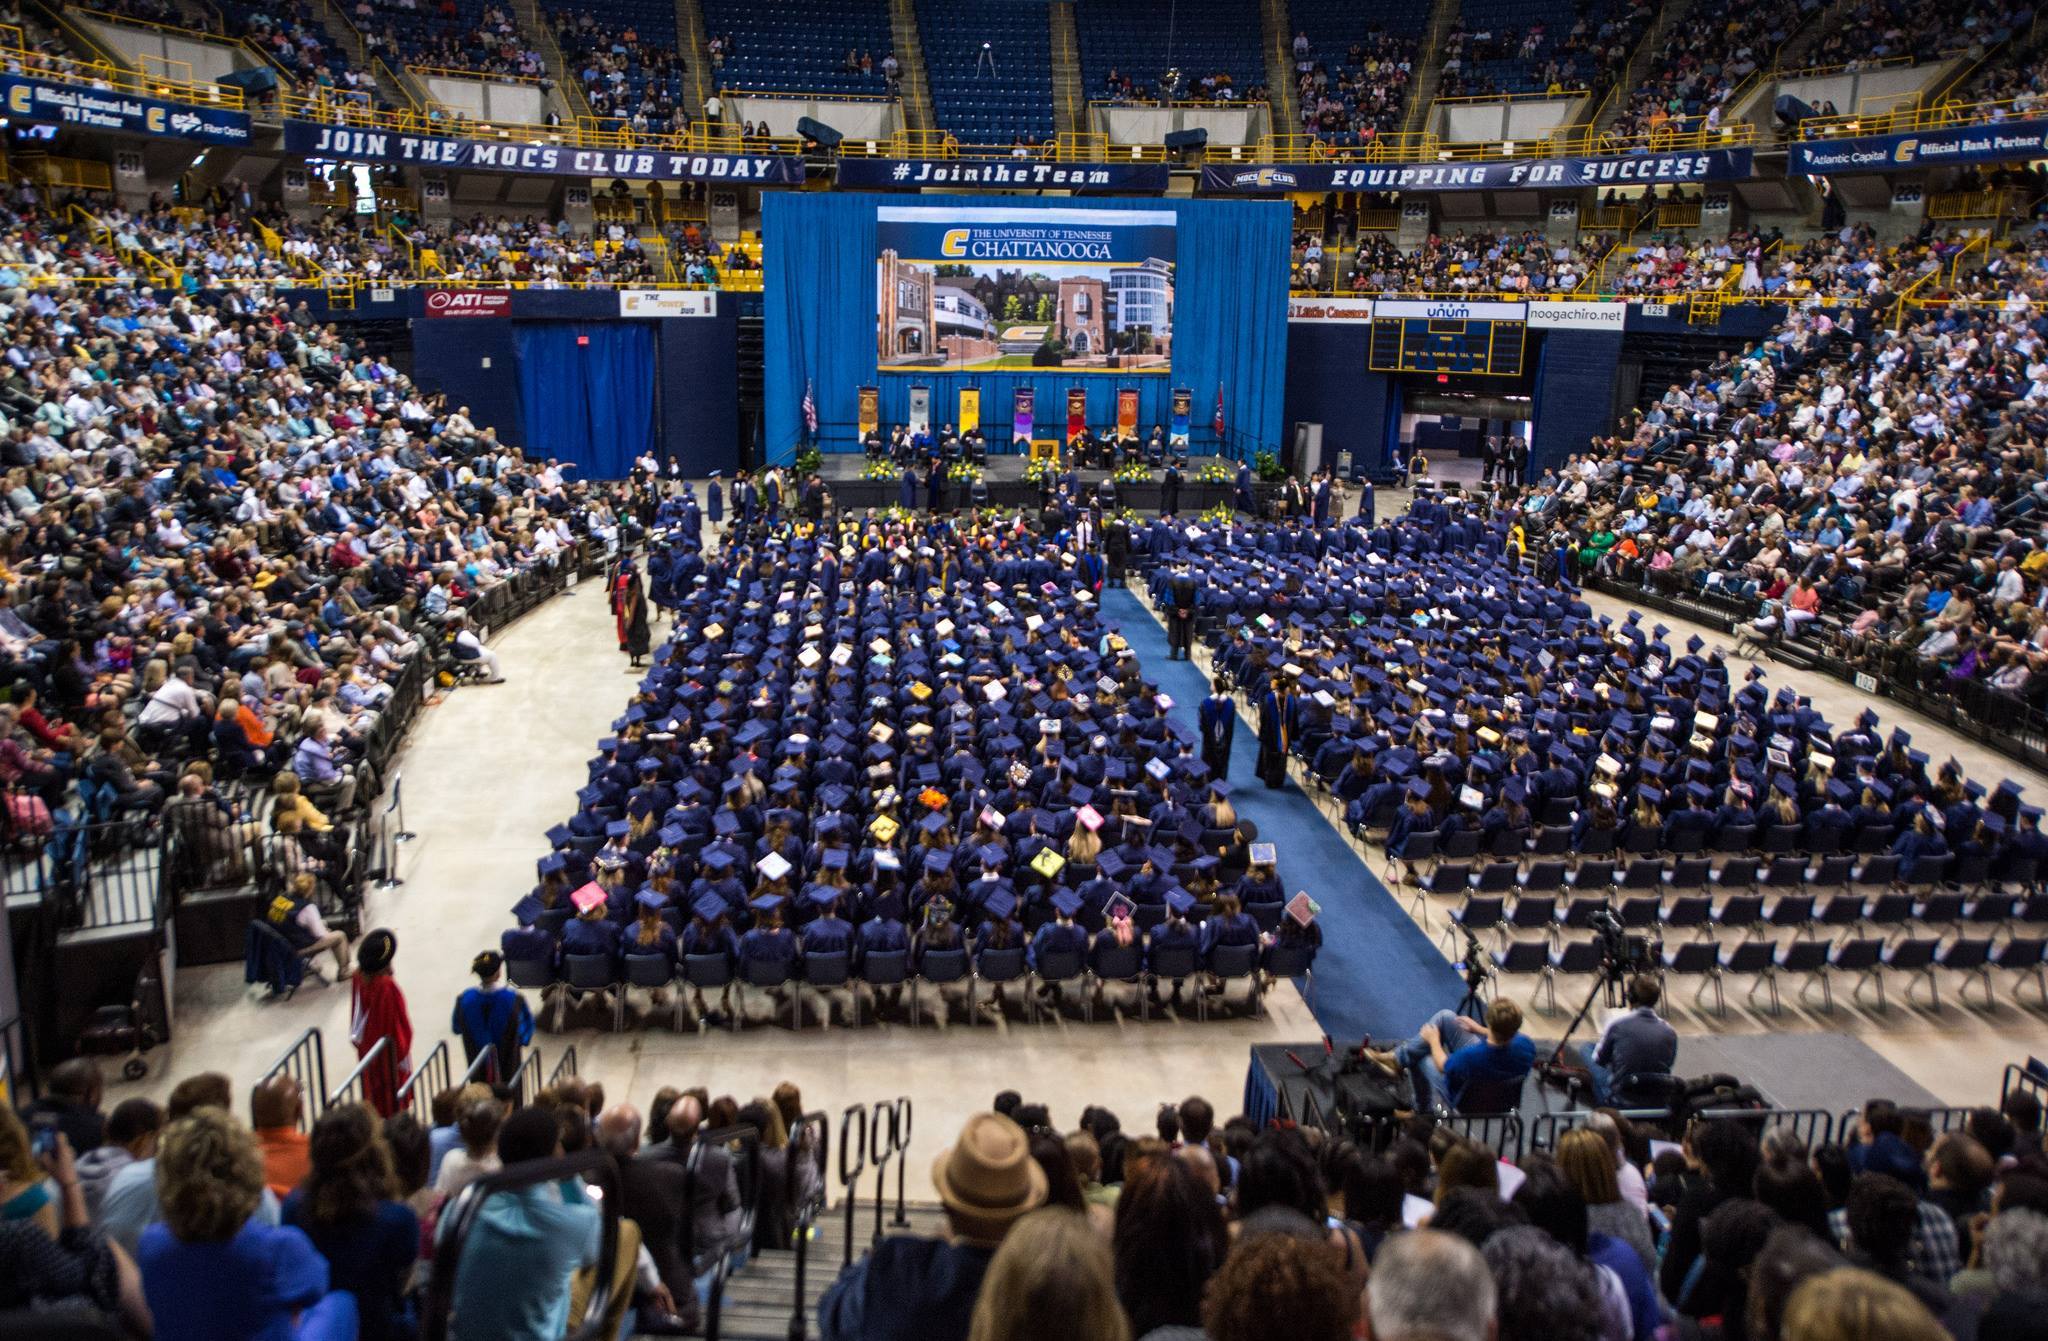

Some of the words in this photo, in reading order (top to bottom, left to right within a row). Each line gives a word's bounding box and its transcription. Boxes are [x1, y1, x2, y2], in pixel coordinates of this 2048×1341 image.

[35, 87, 77, 106] Official
[62, 106, 79, 121] TV
[82, 109, 123, 127] Partner
[315, 129, 387, 155] JOIN
[401, 137, 458, 162] THE
[472, 144, 558, 169] MOCS
[574, 152, 654, 175] CLUB
[669, 157, 771, 178] TODAY
[1919, 141, 1960, 155] Official
[1961, 138, 1991, 151] Bank
[1993, 136, 2041, 149] Partner
[1813, 152, 1849, 166] Atlantic
[1851, 149, 1887, 163] Capital
[893, 163, 1110, 184] #JointheTeam
[1236, 173, 1258, 183] MOCS
[1272, 173, 1294, 184] CLUB
[1331, 167, 1487, 187] EQUIPPING
[1509, 164, 1564, 183] FOR
[1581, 156, 1711, 180] SUCCESS
[426, 181, 446, 197] 219
[1404, 202, 1427, 216] 224
[1551, 201, 1576, 215] 224
[1704, 194, 1729, 210] 225
[941, 228, 971, 257] C
[972, 229, 992, 238] THE
[993, 229, 1048, 239] UNIVERSITY
[1049, 230, 1061, 239] OF
[1062, 231, 1112, 240] TENNESSEE
[972, 241, 1112, 259] CHATTANOOGA
[450, 293, 482, 306] ATI
[1531, 308, 1620, 321] noogachiro.net
[1648, 304, 1664, 314] 125
[1859, 675, 1874, 690] 102
